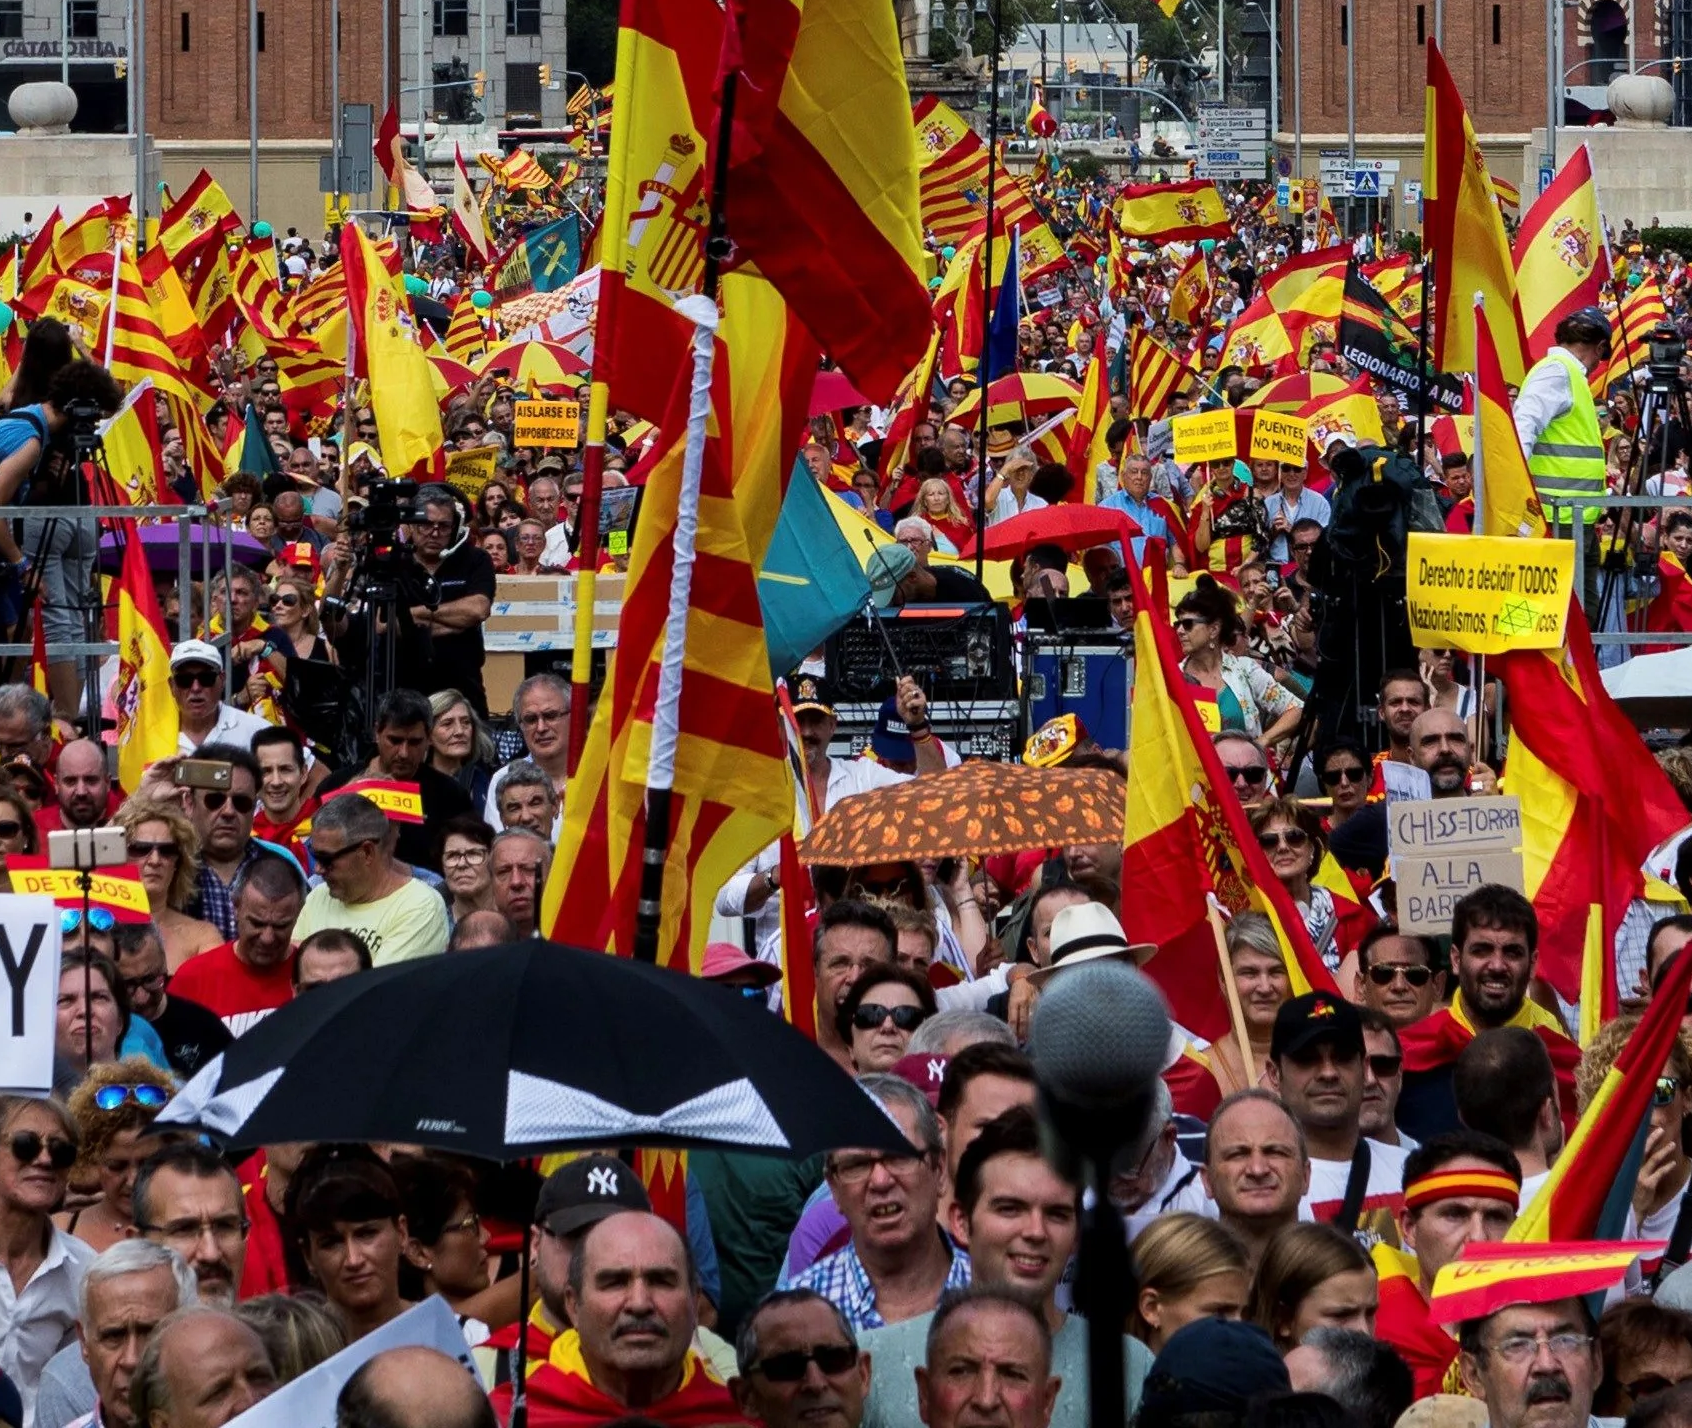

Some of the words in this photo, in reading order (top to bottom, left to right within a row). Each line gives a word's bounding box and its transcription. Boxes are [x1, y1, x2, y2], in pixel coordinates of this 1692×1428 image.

[3, 41, 116, 57] CATALONIA
[1343, 344, 1421, 390] LEGIONARIO
[517, 405, 563, 418] AISLARSE
[566, 406, 578, 418] ES
[516, 427, 577, 440] EMPOBRECERSE.
[1253, 427, 1270, 449] NO
[1419, 558, 1465, 589] Derecho
[1468, 568, 1474, 590] a
[1477, 562, 1515, 592] decidir
[1518, 564, 1560, 595] TODOS.
[1410, 600, 1488, 640] Nazionalismos,
[395, 795, 412, 809] DE
[25, 876, 55, 894] DE
[927, 1058, 947, 1082] NY
[587, 1166, 618, 1196] NY
